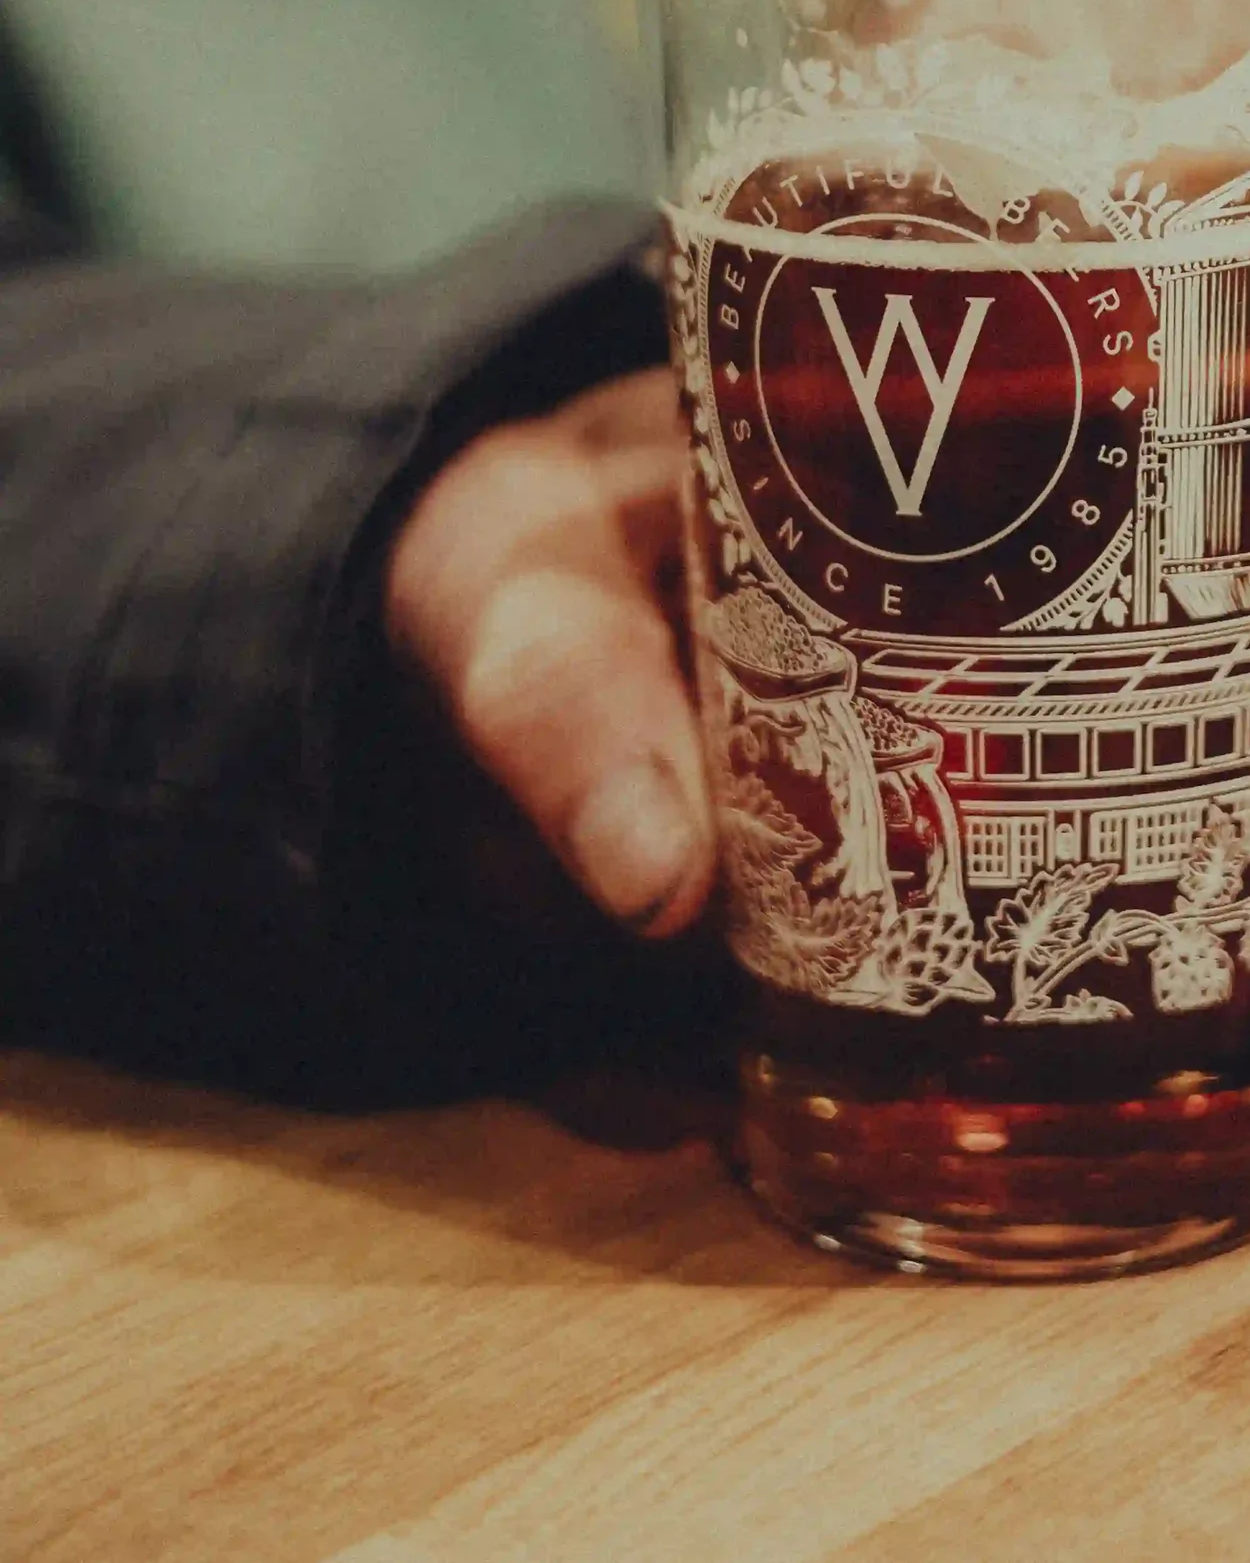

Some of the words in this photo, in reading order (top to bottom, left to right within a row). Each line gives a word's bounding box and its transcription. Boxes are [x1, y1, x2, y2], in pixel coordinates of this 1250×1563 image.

[719, 159, 954, 330] BEUTIFUL
[732, 417, 904, 616] SINCE
[983, 444, 1129, 603] 1985
